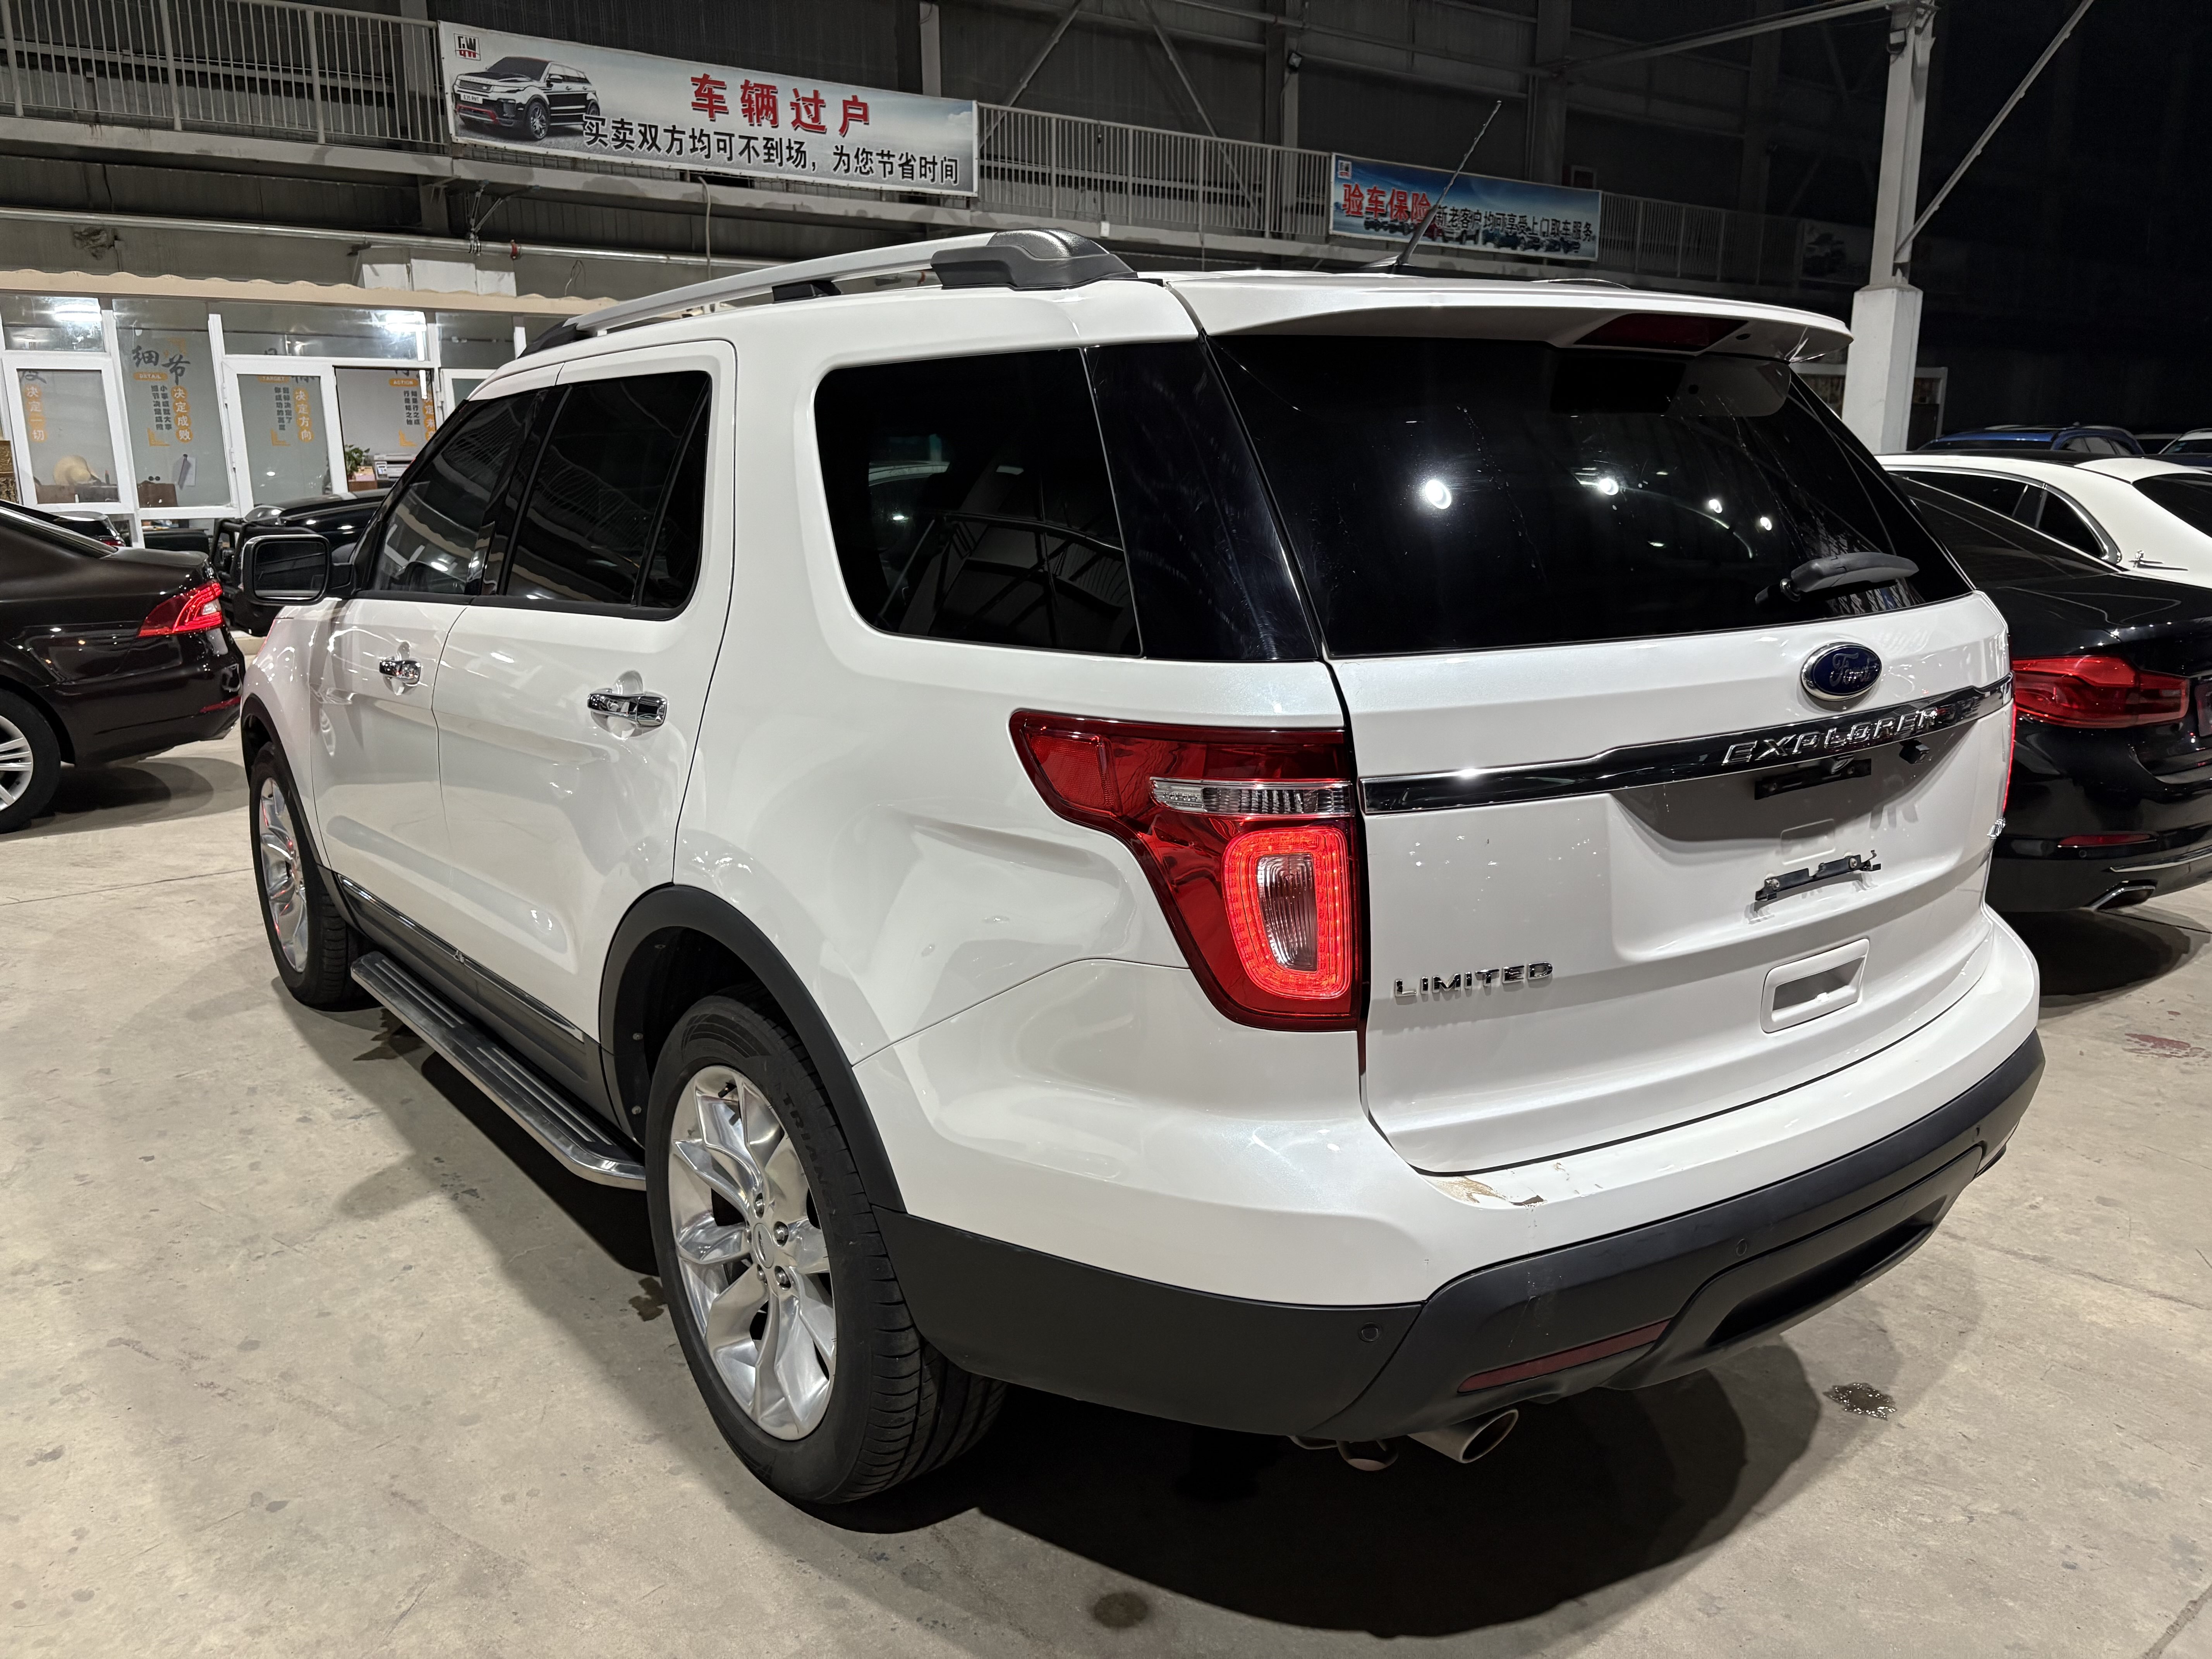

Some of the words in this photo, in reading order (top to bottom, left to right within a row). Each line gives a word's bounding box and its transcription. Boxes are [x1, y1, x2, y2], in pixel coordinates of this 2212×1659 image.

[690, 73, 871, 136] 车辆过户
[582, 115, 958, 185] 买卖双方均可不到场，为您节省时间
[1341, 183, 1433, 223] 验车保险
[1435, 206, 1593, 242] 新老客户均可享受上门取车服务
[132, 345, 191, 386] 细节
[26, 386, 44, 440] 决定一切
[174, 388, 191, 440] 决定成败
[295, 390, 312, 440] 决定方向
[1829, 653, 1879, 688] Ford
[1721, 709, 1939, 766] EXPLORER
[1395, 961, 1553, 997] LIMITED
